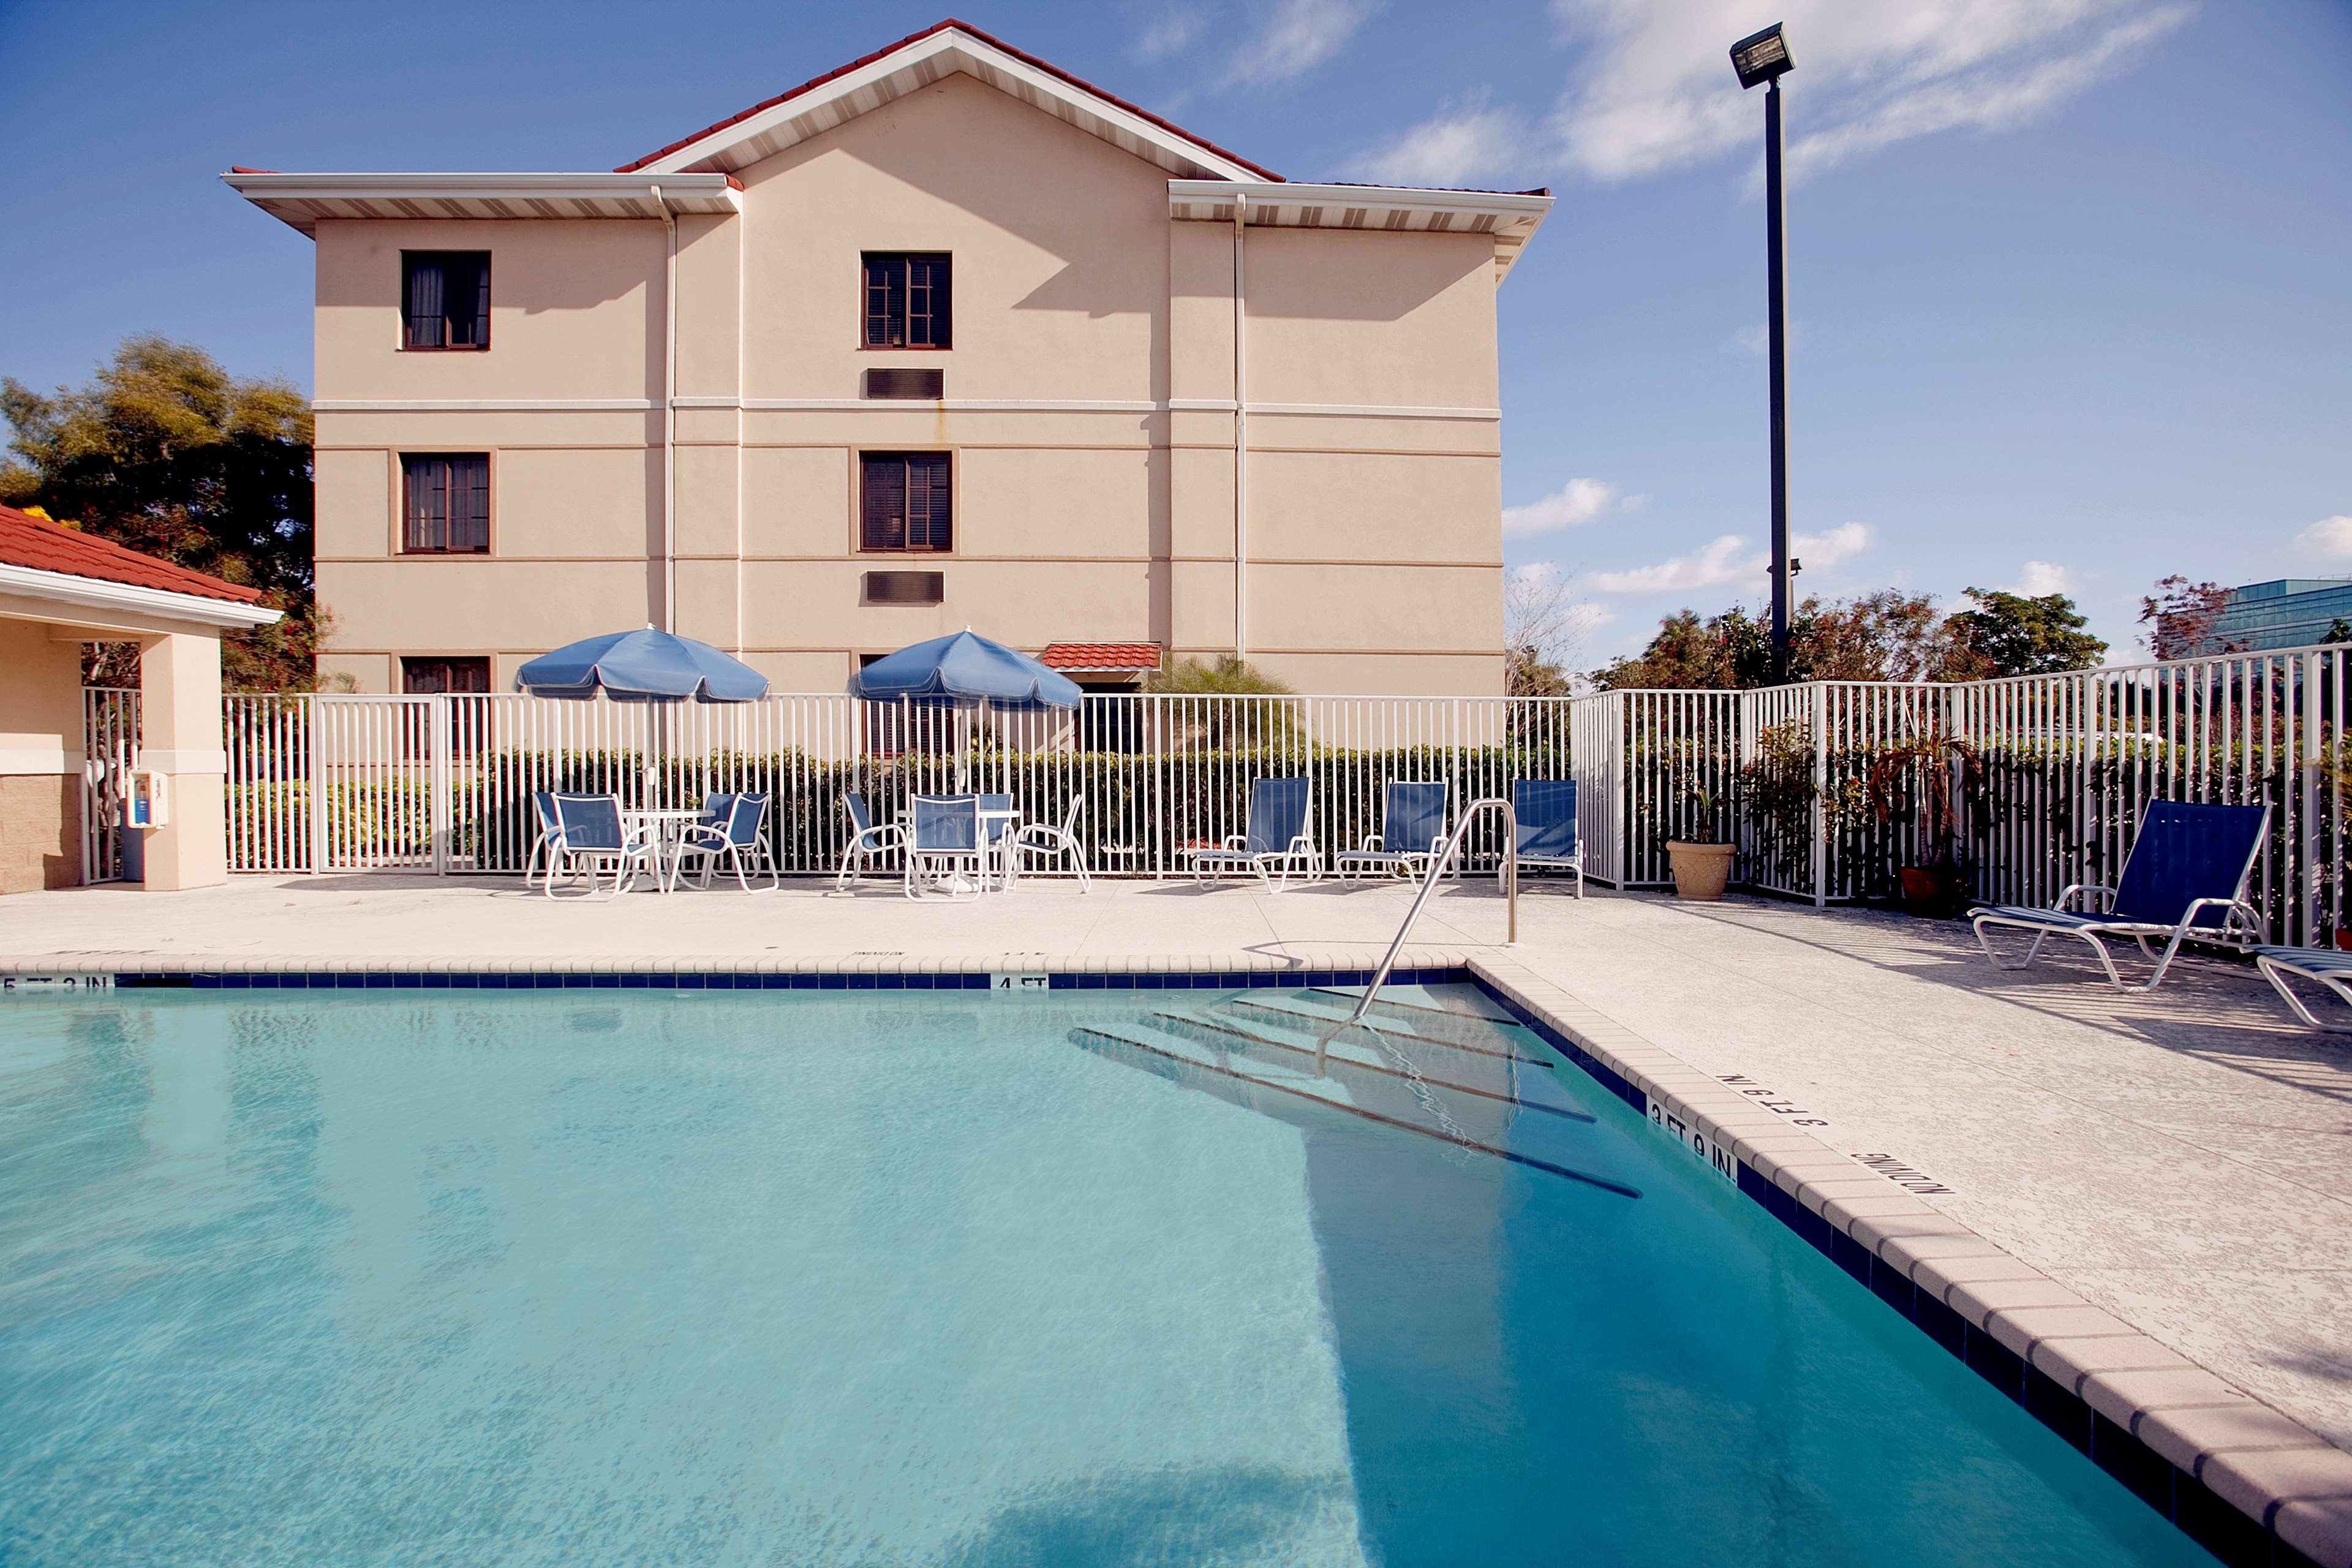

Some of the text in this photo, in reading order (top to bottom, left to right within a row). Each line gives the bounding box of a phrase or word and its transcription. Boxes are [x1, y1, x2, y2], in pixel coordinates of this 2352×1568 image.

[4, 978, 15, 988] 5
[1651, 1103, 1662, 1126] 3
[1667, 1113, 1686, 1142] FT
[1694, 1133, 1705, 1157] 9
[1850, 1153, 1957, 1194] NO DIVING
